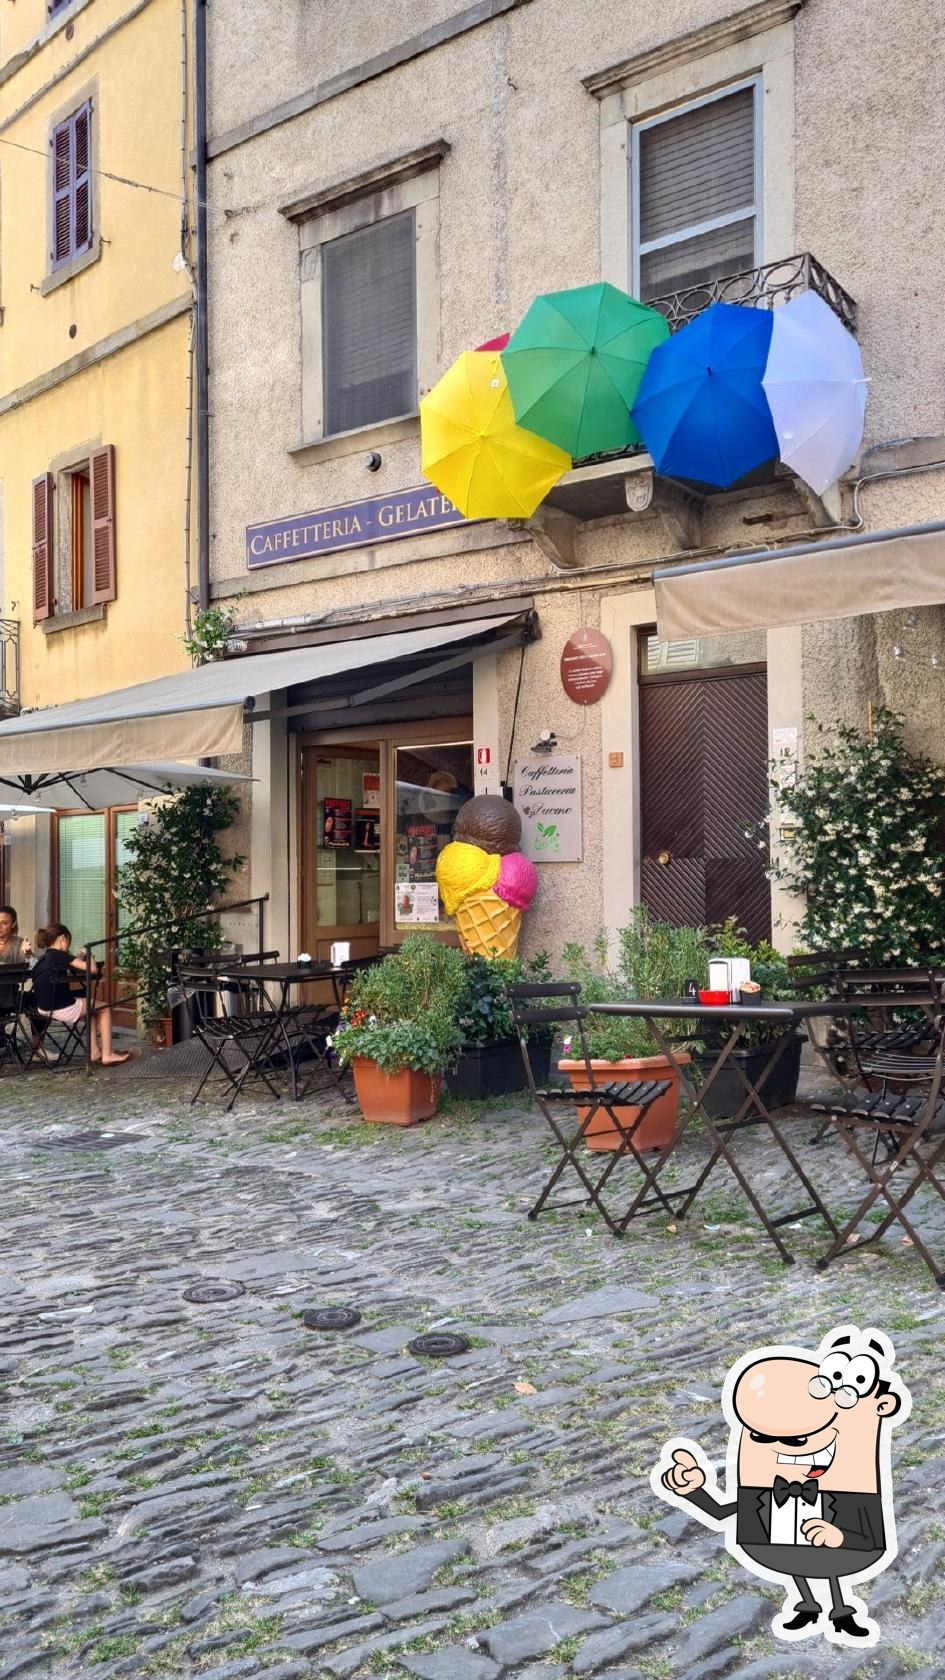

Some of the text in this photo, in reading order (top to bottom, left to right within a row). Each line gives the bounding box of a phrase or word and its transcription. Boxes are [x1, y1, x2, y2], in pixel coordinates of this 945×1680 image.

[521, 764, 574, 781] Caffetteria
[519, 784, 576, 797] Pasticceria
[531, 801, 572, 816] Duomo
[688, 982, 697, 996] 4
